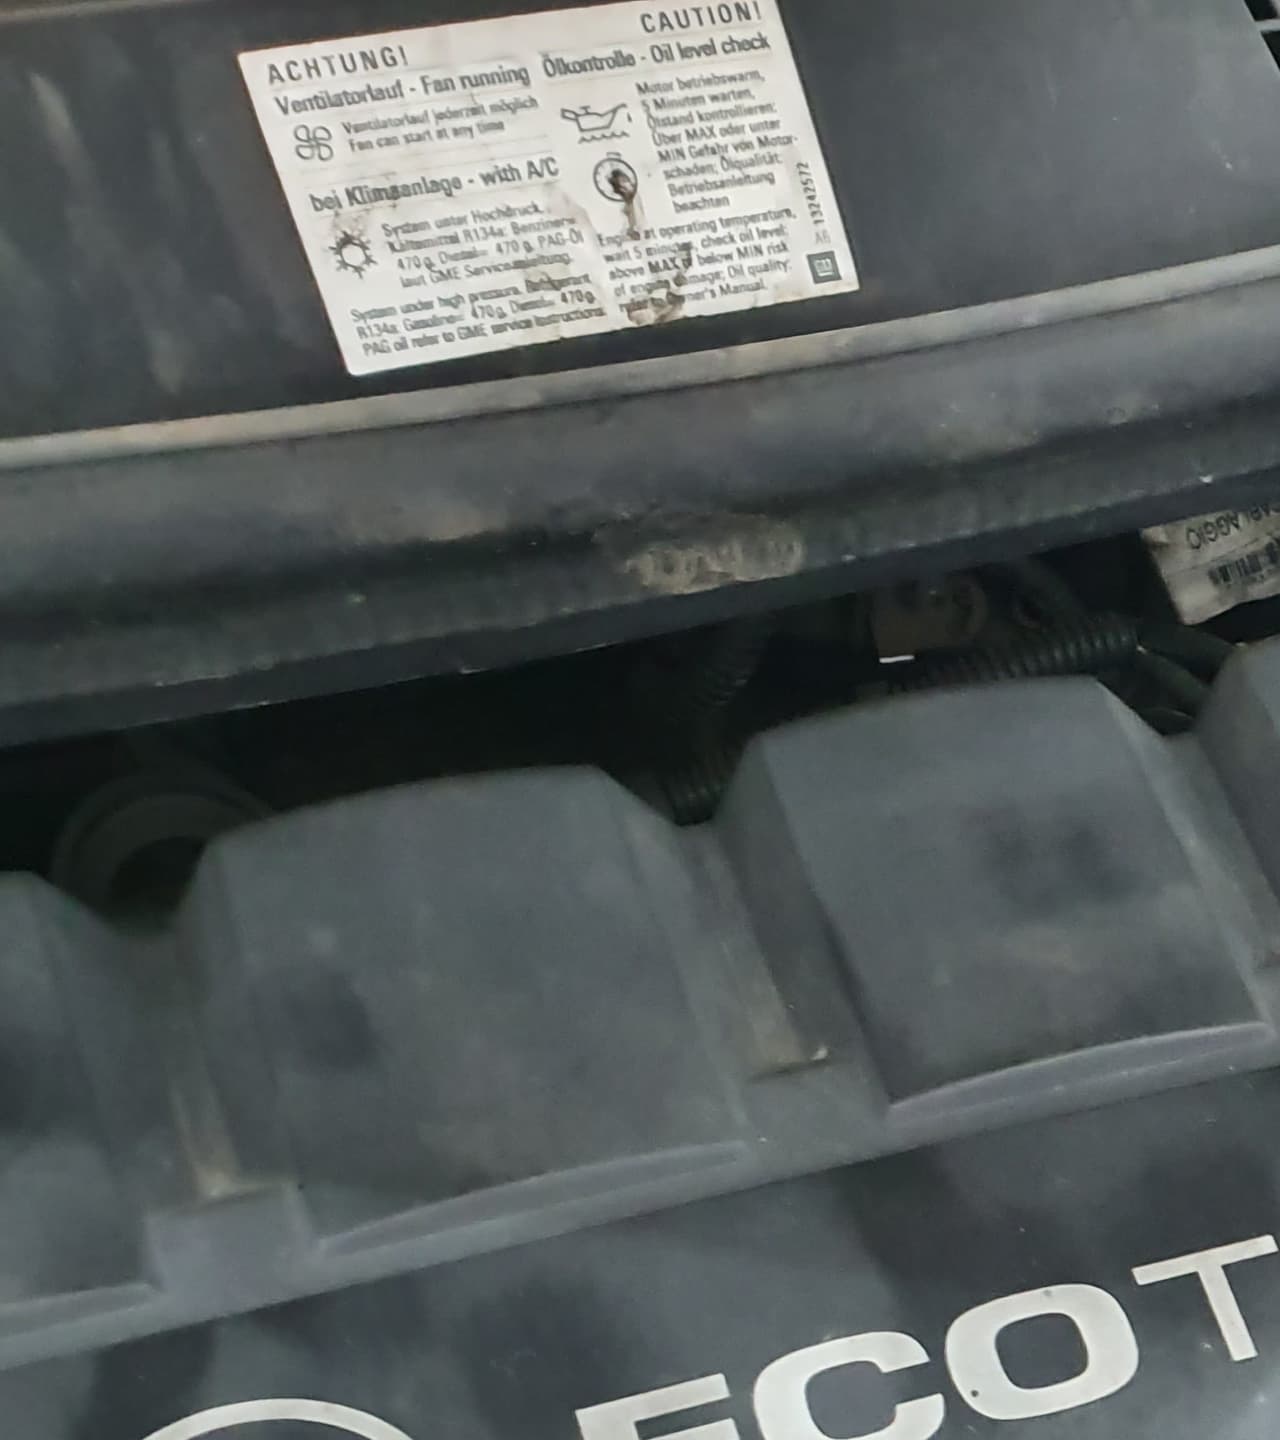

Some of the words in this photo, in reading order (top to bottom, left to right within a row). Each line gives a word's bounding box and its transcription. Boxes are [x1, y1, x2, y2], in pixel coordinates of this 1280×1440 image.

[640, 0, 760, 32] CAUTION!
[268, 45, 407, 83] ACHTUNG!
[542, 50, 635, 77] Ölkontrolle
[650, 43, 674, 63] Oil
[676, 37, 717, 59] level
[721, 32, 770, 54] check
[274, 79, 403, 114] Ventilatorlauf
[419, 75, 456, 94] Fan
[459, 65, 530, 89] running
[635, 81, 673, 94] Motor
[652, 95, 705, 110] Minuten
[348, 138, 373, 152] Fan
[375, 135, 399, 147] can
[402, 129, 432, 144] start
[435, 127, 448, 139] at
[451, 126, 473, 138] any
[476, 120, 504, 133] time
[684, 125, 716, 140] MAX
[718, 122, 745, 137] oder
[748, 119, 780, 132] unter
[657, 148, 685, 161] MIN
[687, 142, 728, 158] Gefahr
[732, 140, 754, 152] von
[309, 190, 342, 212] bei
[345, 176, 461, 205] Klimaanlage
[480, 163, 521, 185] with
[526, 156, 558, 179] A/C
[667, 171, 775, 196] Betriebsanleitung
[672, 196, 729, 213] beachten
[658, 220, 717, 238] operating
[632, 245, 642, 259] 5
[700, 231, 736, 248] check
[738, 228, 754, 242] oil
[647, 256, 680, 273] MAX
[735, 245, 763, 258] MIN
[766, 240, 788, 254] risk
[727, 264, 744, 278] Oil
